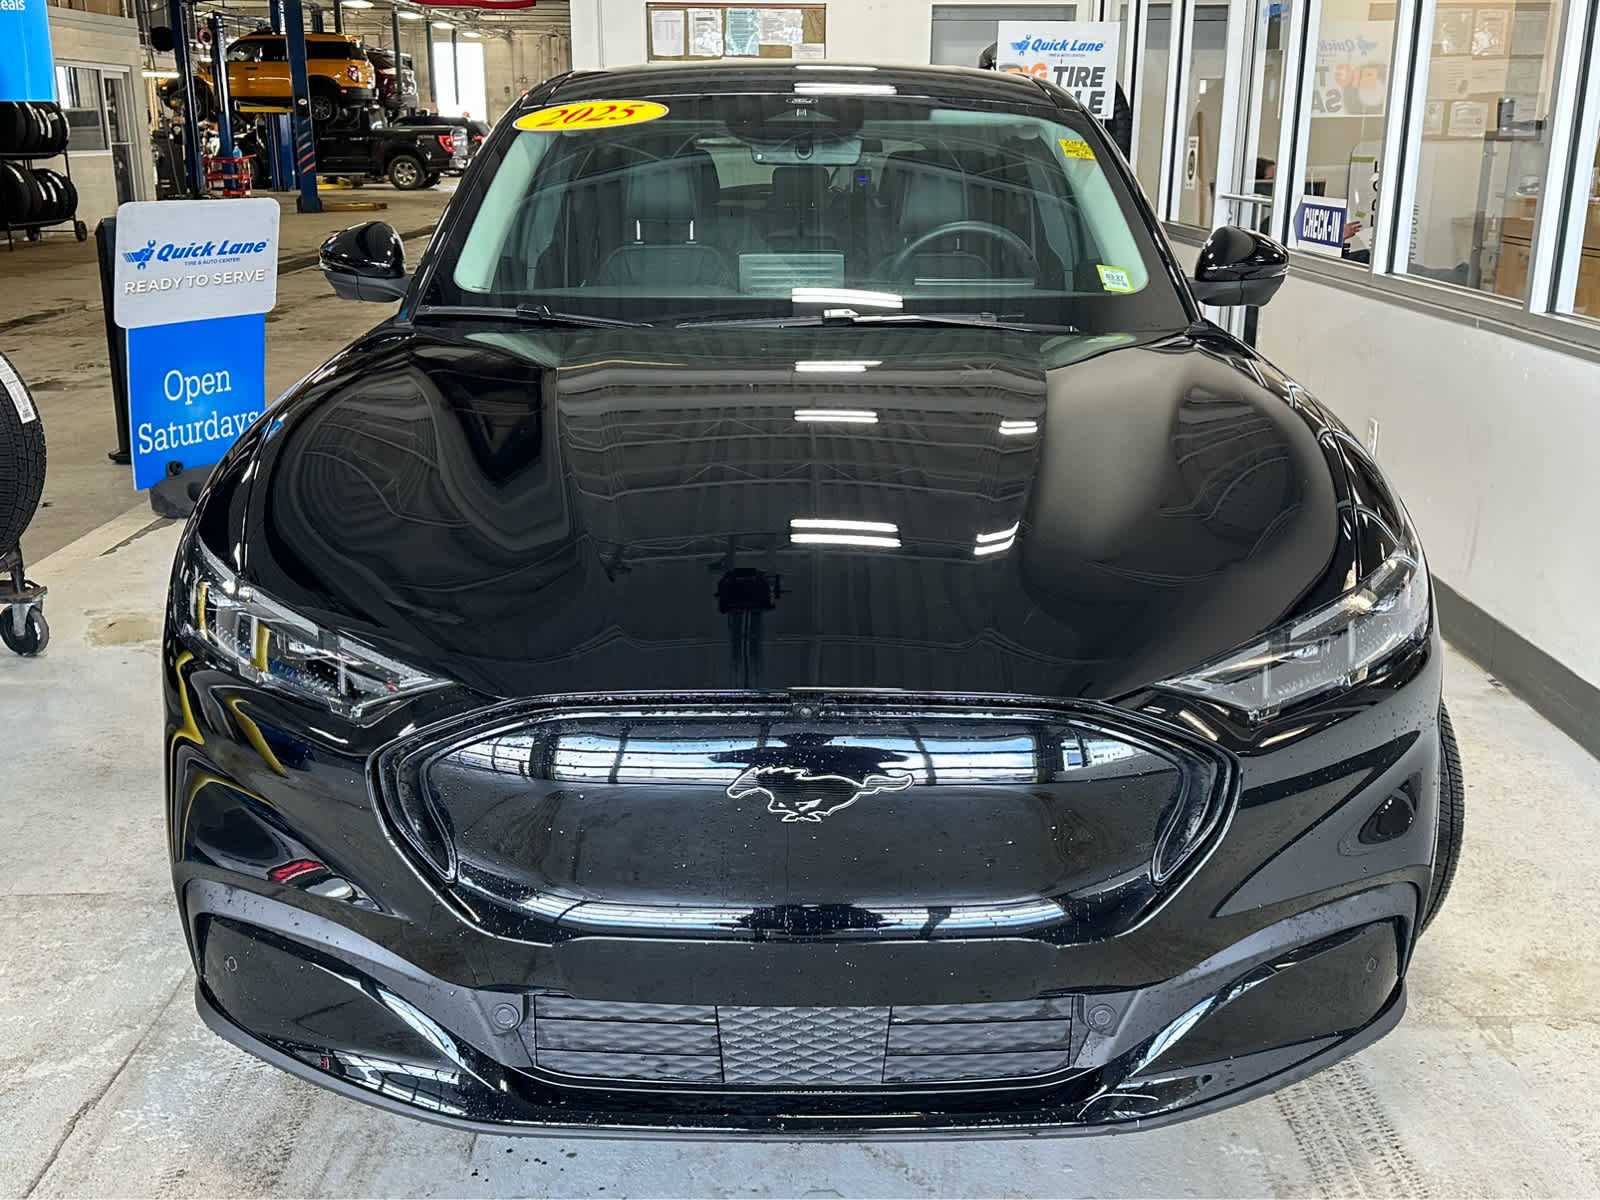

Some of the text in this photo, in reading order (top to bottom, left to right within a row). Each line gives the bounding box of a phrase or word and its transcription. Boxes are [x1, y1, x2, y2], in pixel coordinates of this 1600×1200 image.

[1031, 38, 1104, 52] Quick Lane
[1053, 66, 1106, 87] TIRE
[536, 104, 645, 128] 2025
[1302, 207, 1342, 244] CHECK-IN
[156, 239, 267, 262] Quick Lane
[124, 269, 265, 294] READY TO SERVE
[164, 369, 232, 405] Open
